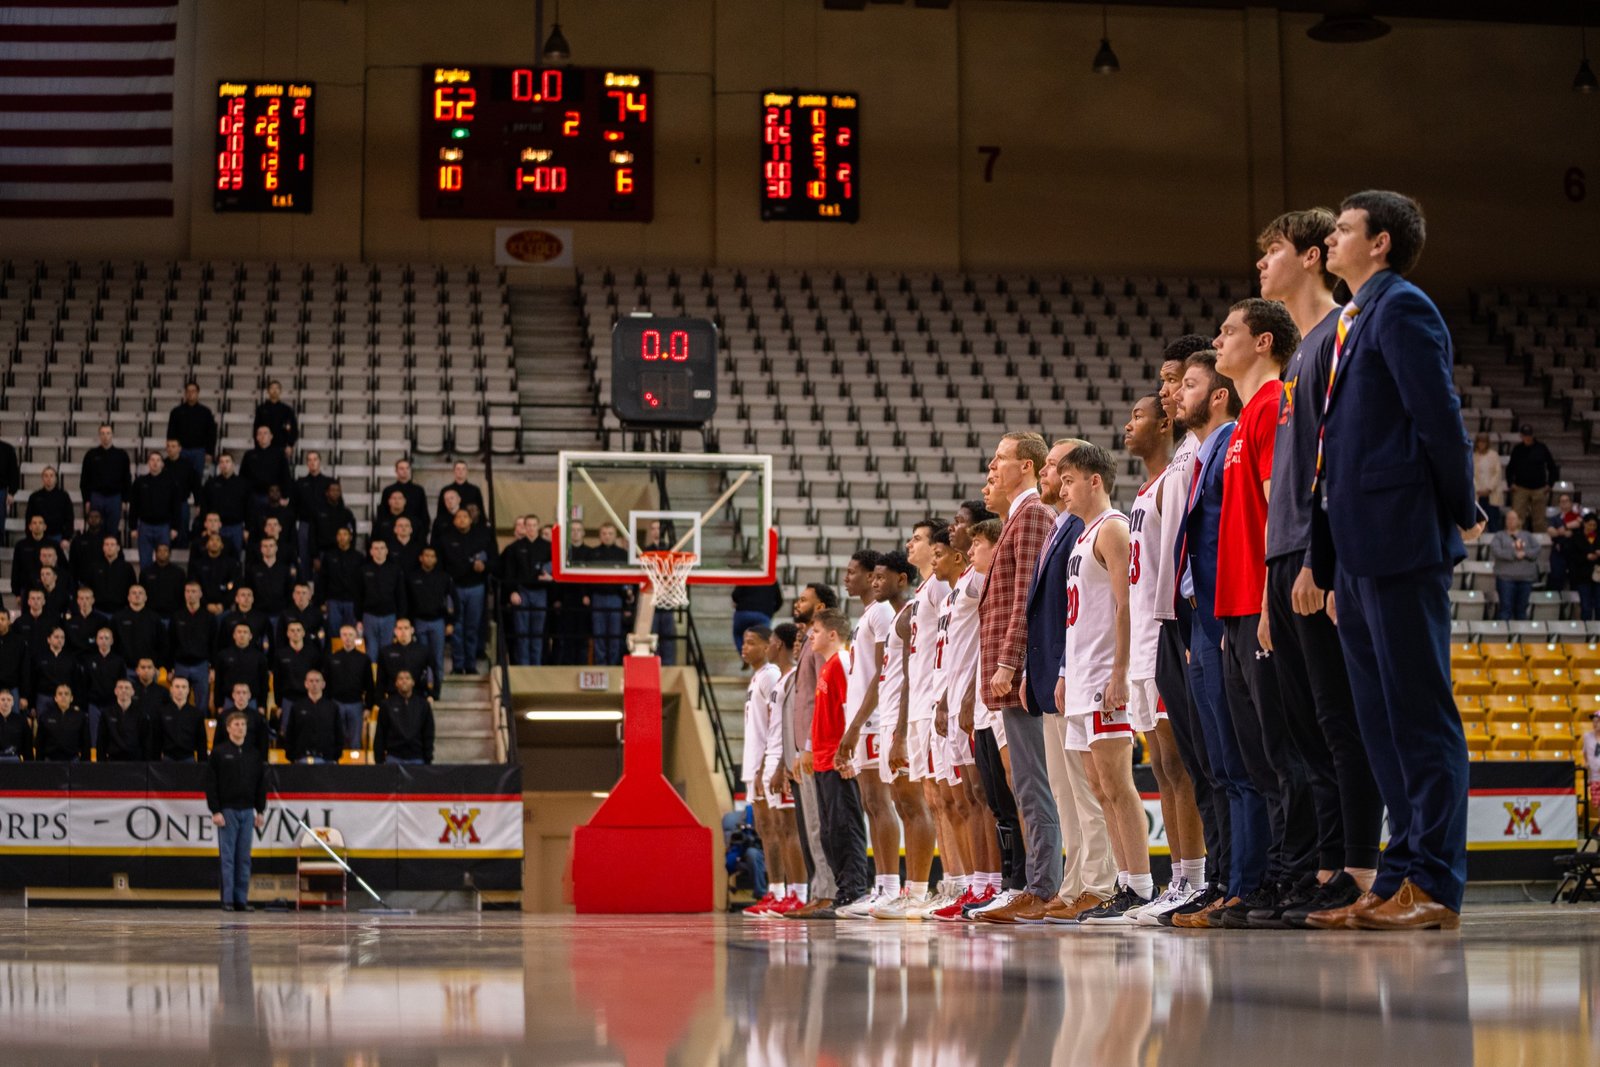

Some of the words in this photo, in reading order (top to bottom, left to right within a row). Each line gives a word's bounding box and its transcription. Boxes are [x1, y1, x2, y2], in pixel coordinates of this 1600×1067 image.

[511, 69, 563, 102] 0.0
[228, 98, 245, 116] 12
[267, 98, 280, 116] 2
[293, 98, 306, 117] 2
[435, 87, 476, 121] 62
[607, 90, 647, 122] 74
[220, 116, 245, 135] 02
[255, 116, 280, 135] 22
[299, 117, 306, 135] 1
[563, 110, 580, 136] 2
[765, 107, 791, 125] 21
[811, 108, 826, 126] 0
[227, 134, 245, 152] 10
[267, 135, 280, 152] 4
[765, 125, 791, 144] 05
[811, 126, 826, 145] 2
[836, 127, 851, 147] 2
[219, 152, 244, 170] 00
[261, 152, 279, 171] 13
[298, 153, 305, 171] 1
[772, 144, 791, 161] 11
[765, 161, 791, 179] 00
[836, 162, 851, 182] 2
[978, 146, 1000, 182] 7
[266, 170, 279, 191] 6
[440, 165, 462, 191] 10
[616, 168, 634, 193] 6
[1565, 167, 1586, 202] 6
[844, 182, 852, 199] 1
[641, 329, 689, 362] 0.0
[584, 671, 605, 688] EXIT
[0, 812, 68, 841] RPS
